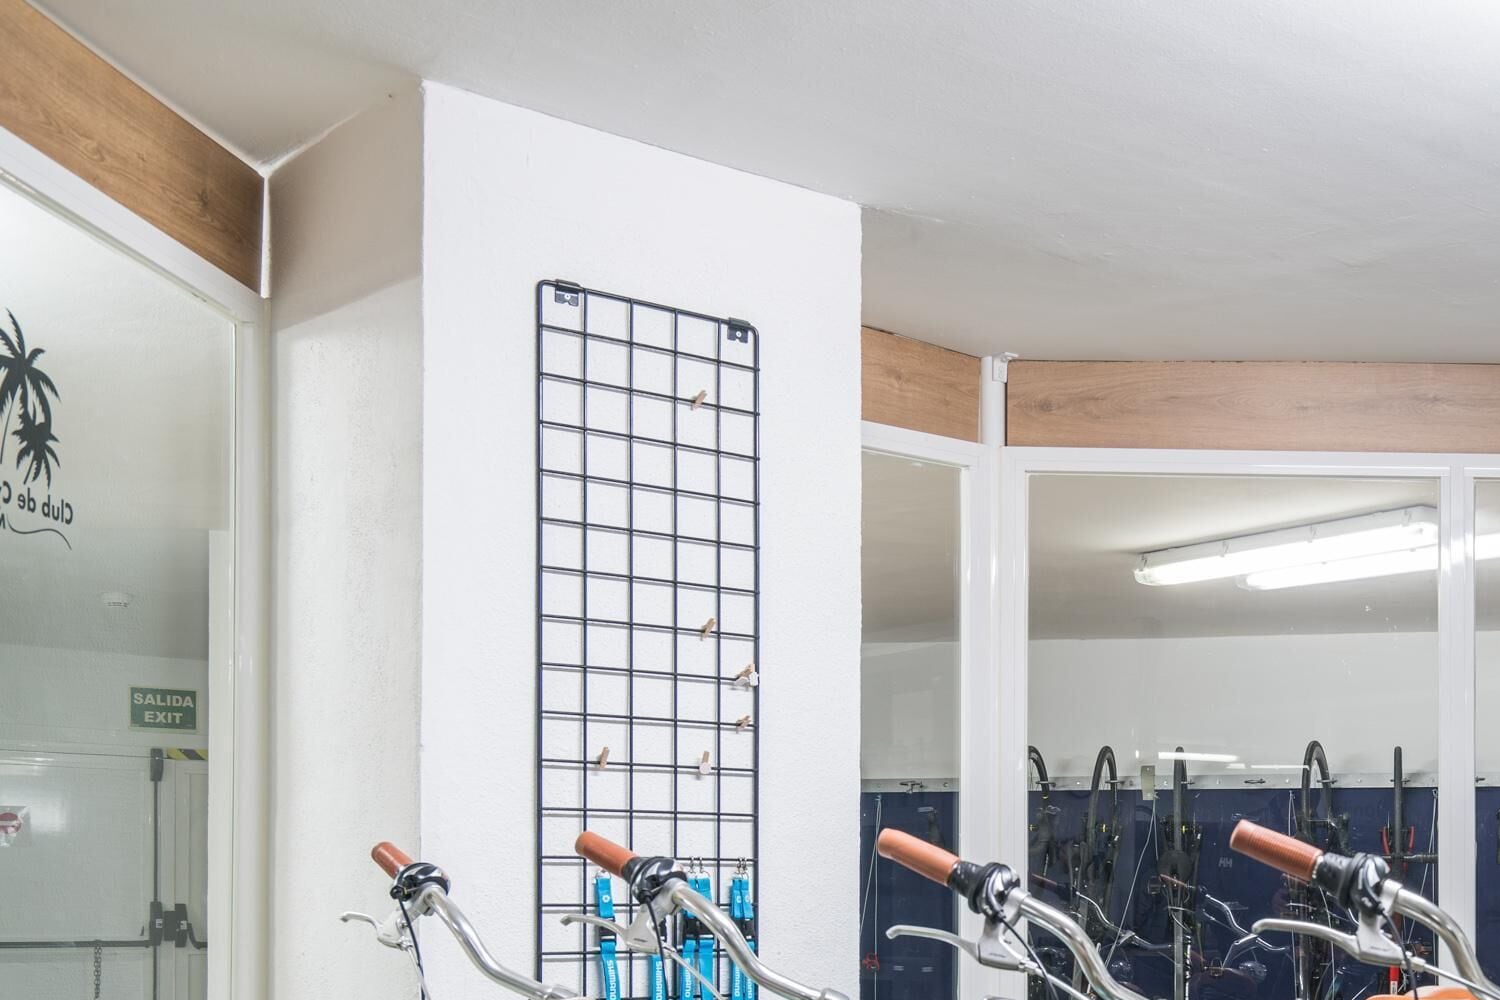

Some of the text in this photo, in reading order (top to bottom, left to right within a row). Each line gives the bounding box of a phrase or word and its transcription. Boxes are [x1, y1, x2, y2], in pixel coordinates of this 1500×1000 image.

[133, 692, 194, 708] SALIDA
[144, 710, 183, 724] EXIT
[606, 959, 617, 1000] SHIMANO
